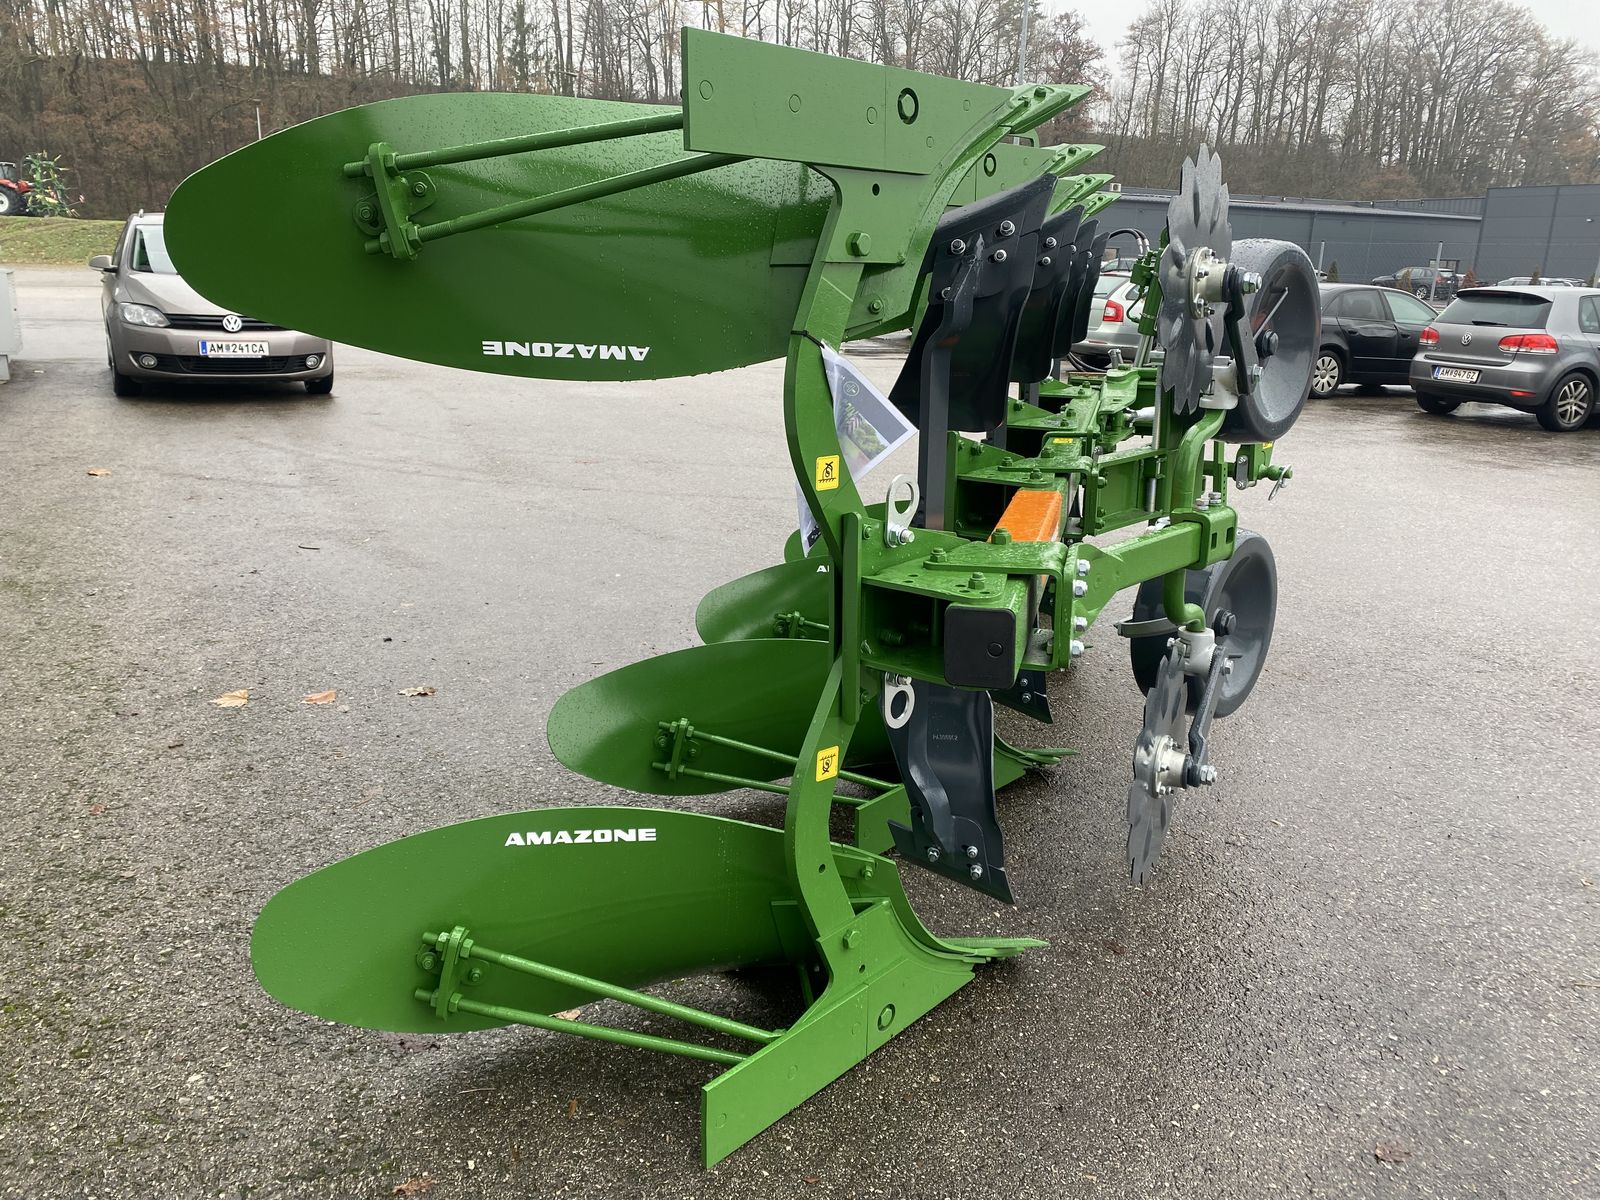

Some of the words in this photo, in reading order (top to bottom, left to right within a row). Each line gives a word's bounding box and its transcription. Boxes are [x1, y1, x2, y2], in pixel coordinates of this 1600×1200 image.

[209, 343, 224, 353] AM
[482, 340, 651, 361] AMAZONE
[1440, 368, 1451, 377] AM
[504, 828, 657, 847] AMAZONE
